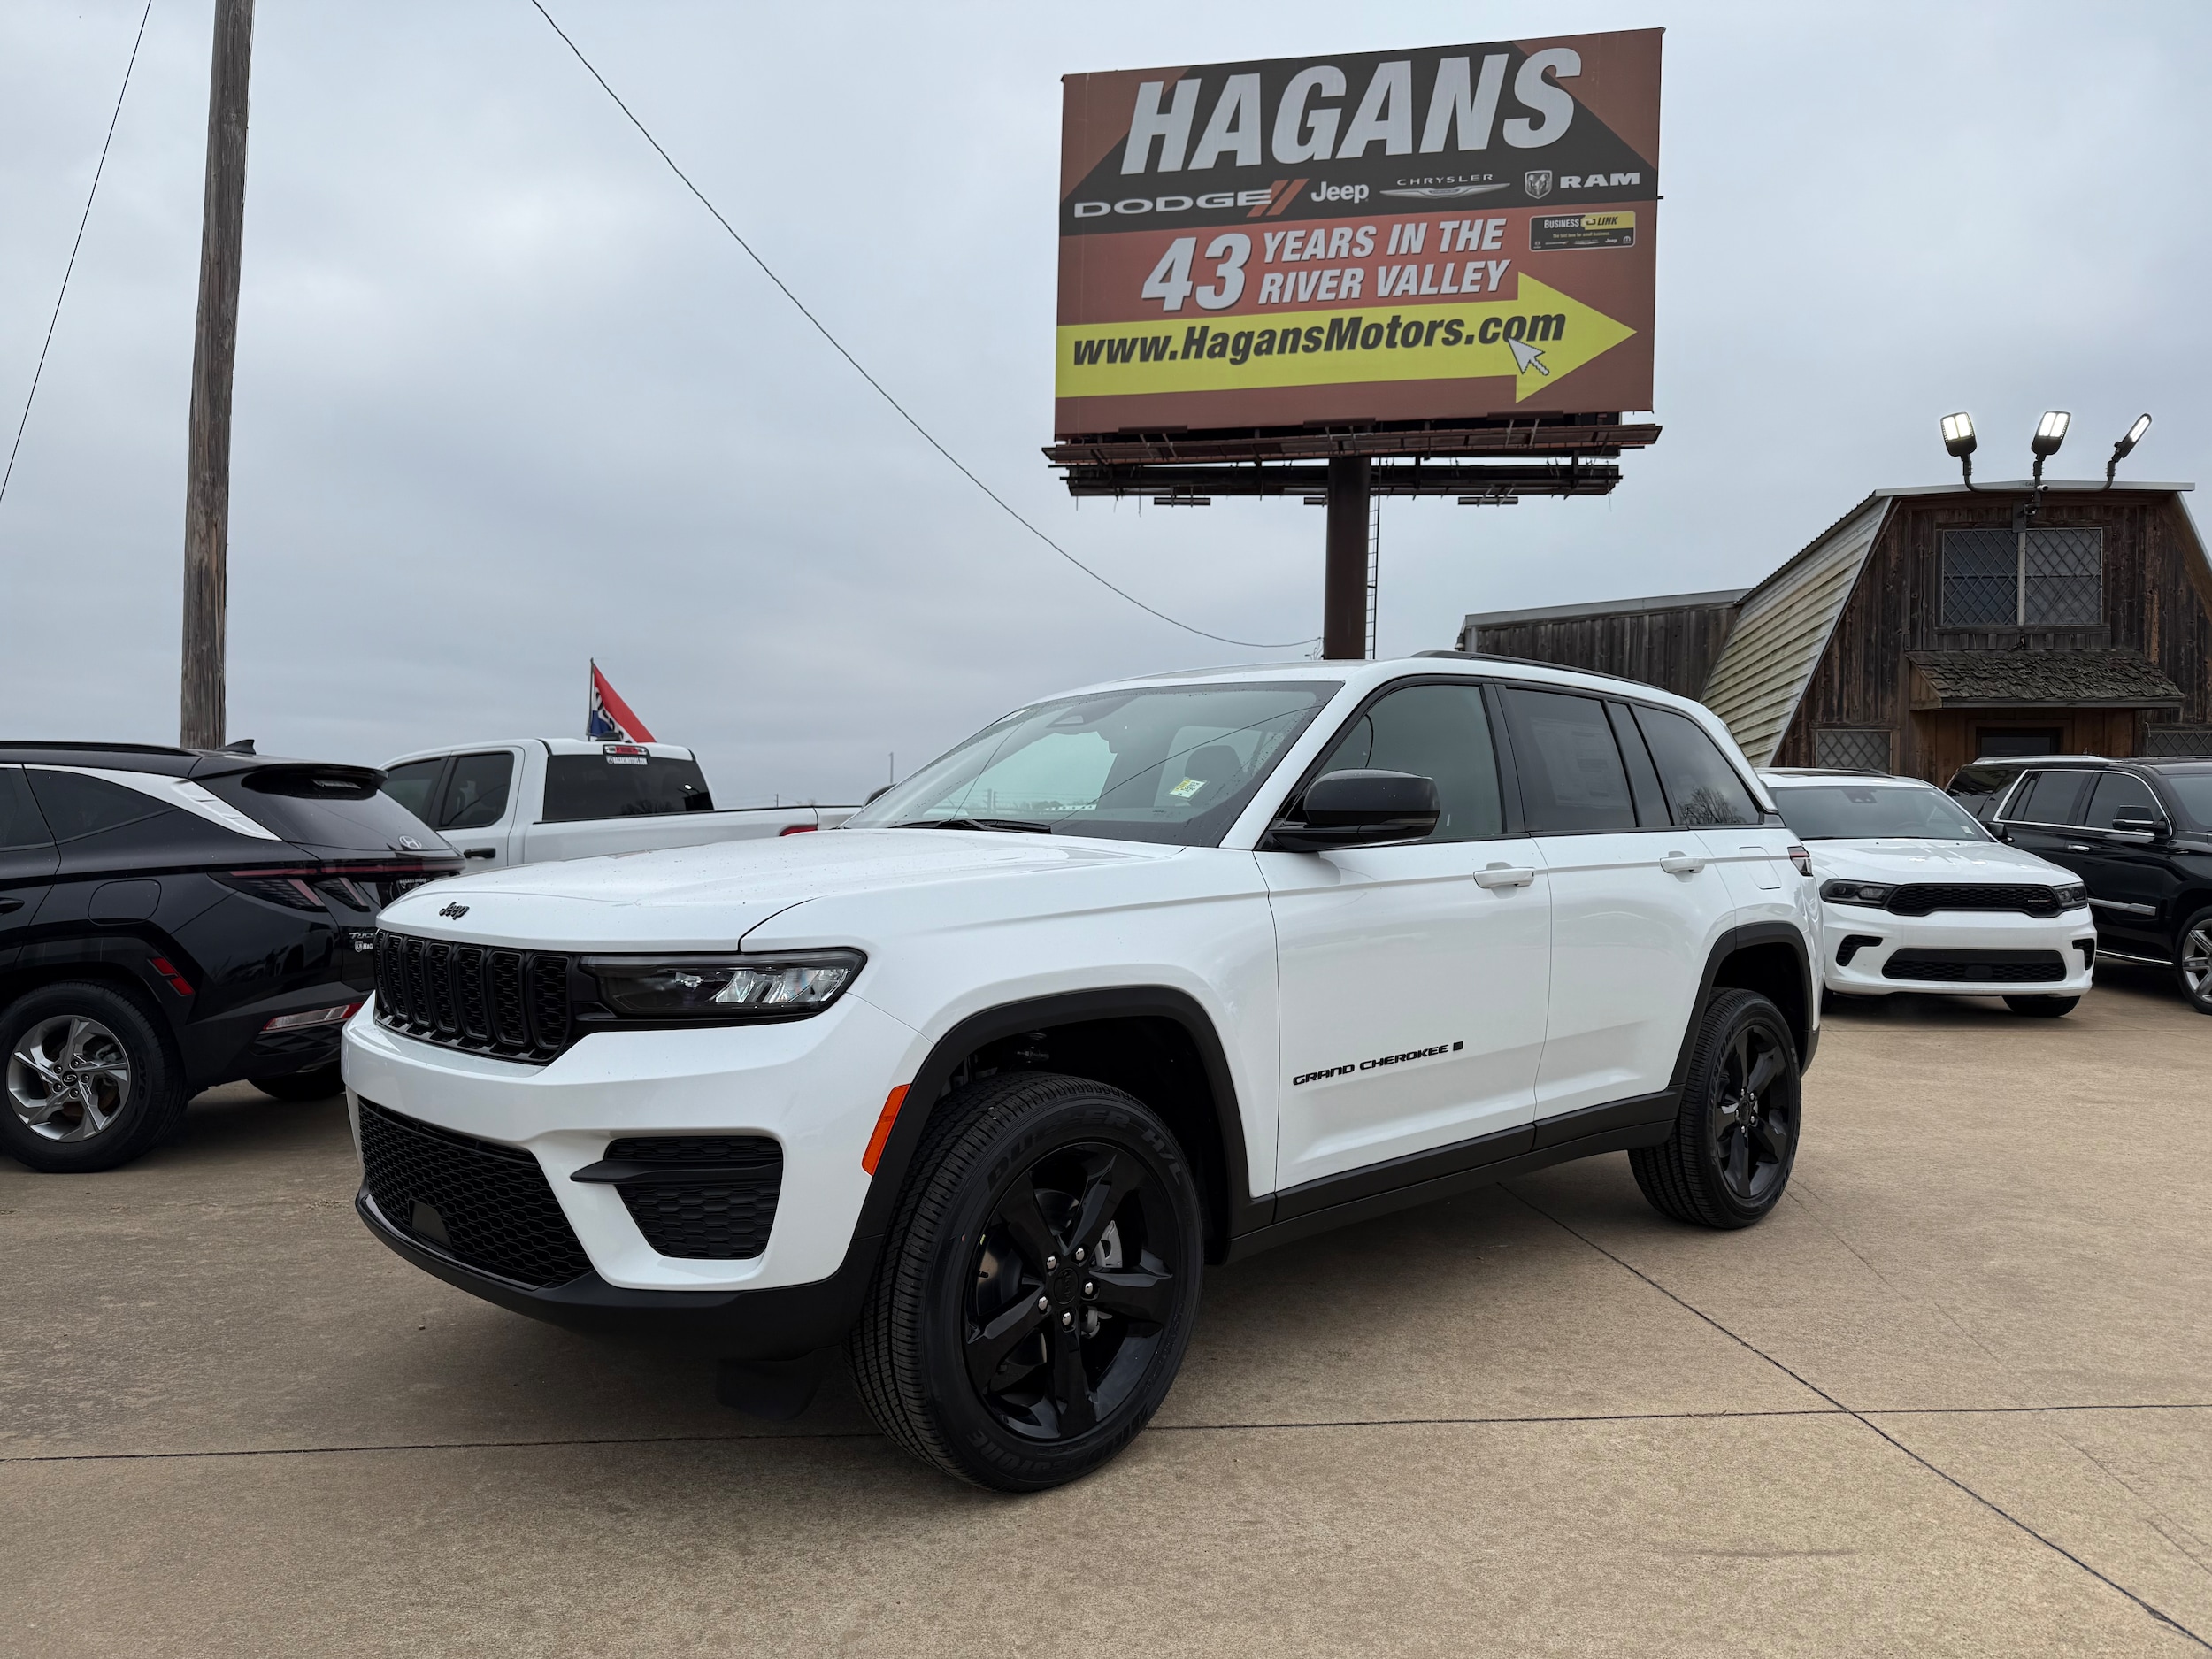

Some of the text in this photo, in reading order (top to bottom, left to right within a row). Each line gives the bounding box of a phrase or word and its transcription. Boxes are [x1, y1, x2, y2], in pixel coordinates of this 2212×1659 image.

[1119, 47, 1583, 176] HAGANS
[1310, 180, 1369, 204] Jeep
[1396, 173, 1494, 186] CHRYSLER
[1559, 172, 1641, 189] RAM
[1073, 188, 1272, 218] DODGE
[1543, 216, 1618, 229] BUSINESS LINK
[1263, 218, 1507, 264] YEARS IN THE
[1141, 232, 1252, 312] 43
[1257, 259, 1511, 305] RIVER VALLEY
[1072, 312, 1566, 366] www.HagansMotors.com
[439, 901, 470, 921] Jeep
[1293, 1044, 1449, 1086] GRAND CHEROKEE
